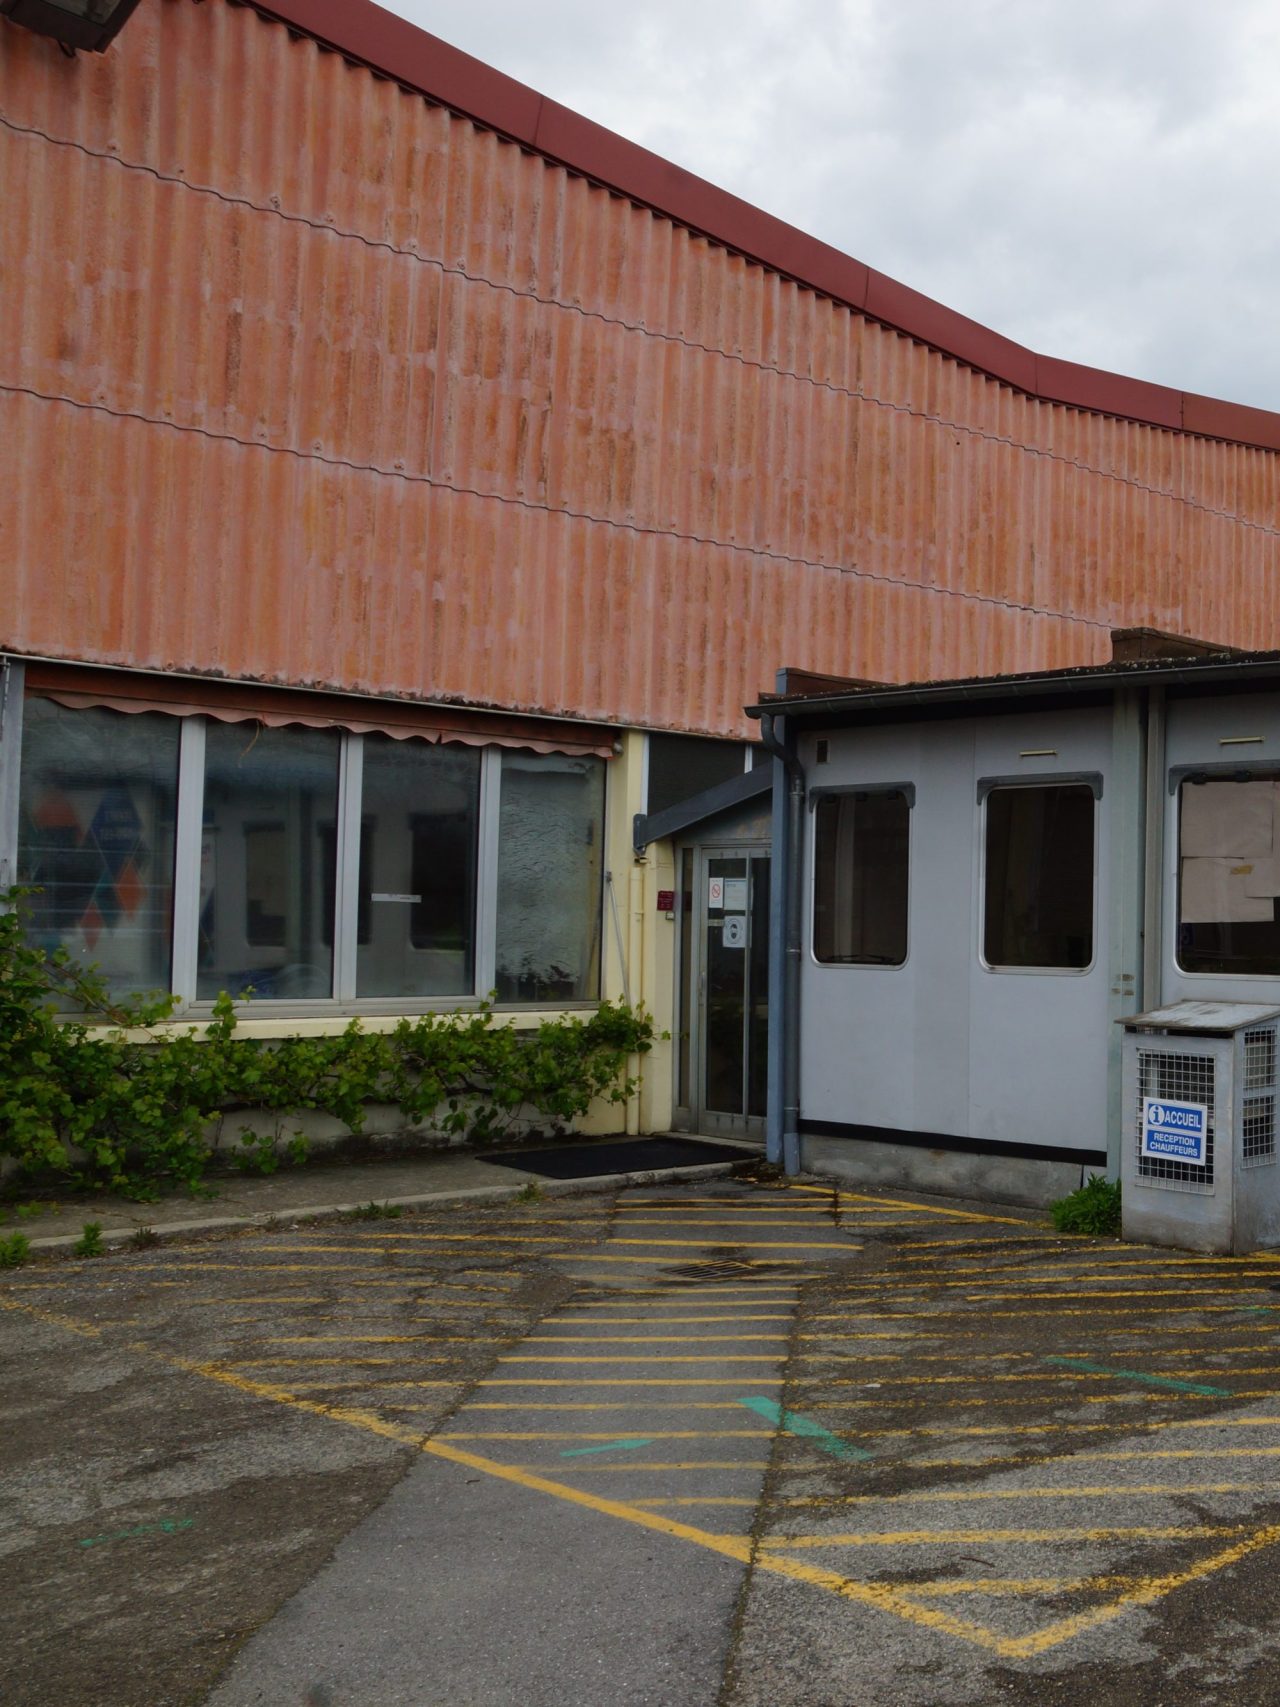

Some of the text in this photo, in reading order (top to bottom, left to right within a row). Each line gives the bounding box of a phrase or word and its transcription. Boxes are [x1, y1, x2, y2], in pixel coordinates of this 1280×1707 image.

[1164, 1110, 1201, 1127] ACCUEIL
[1154, 1133, 1195, 1146] RECEPTION
[1150, 1142, 1197, 1156] CHAUFFEURS
